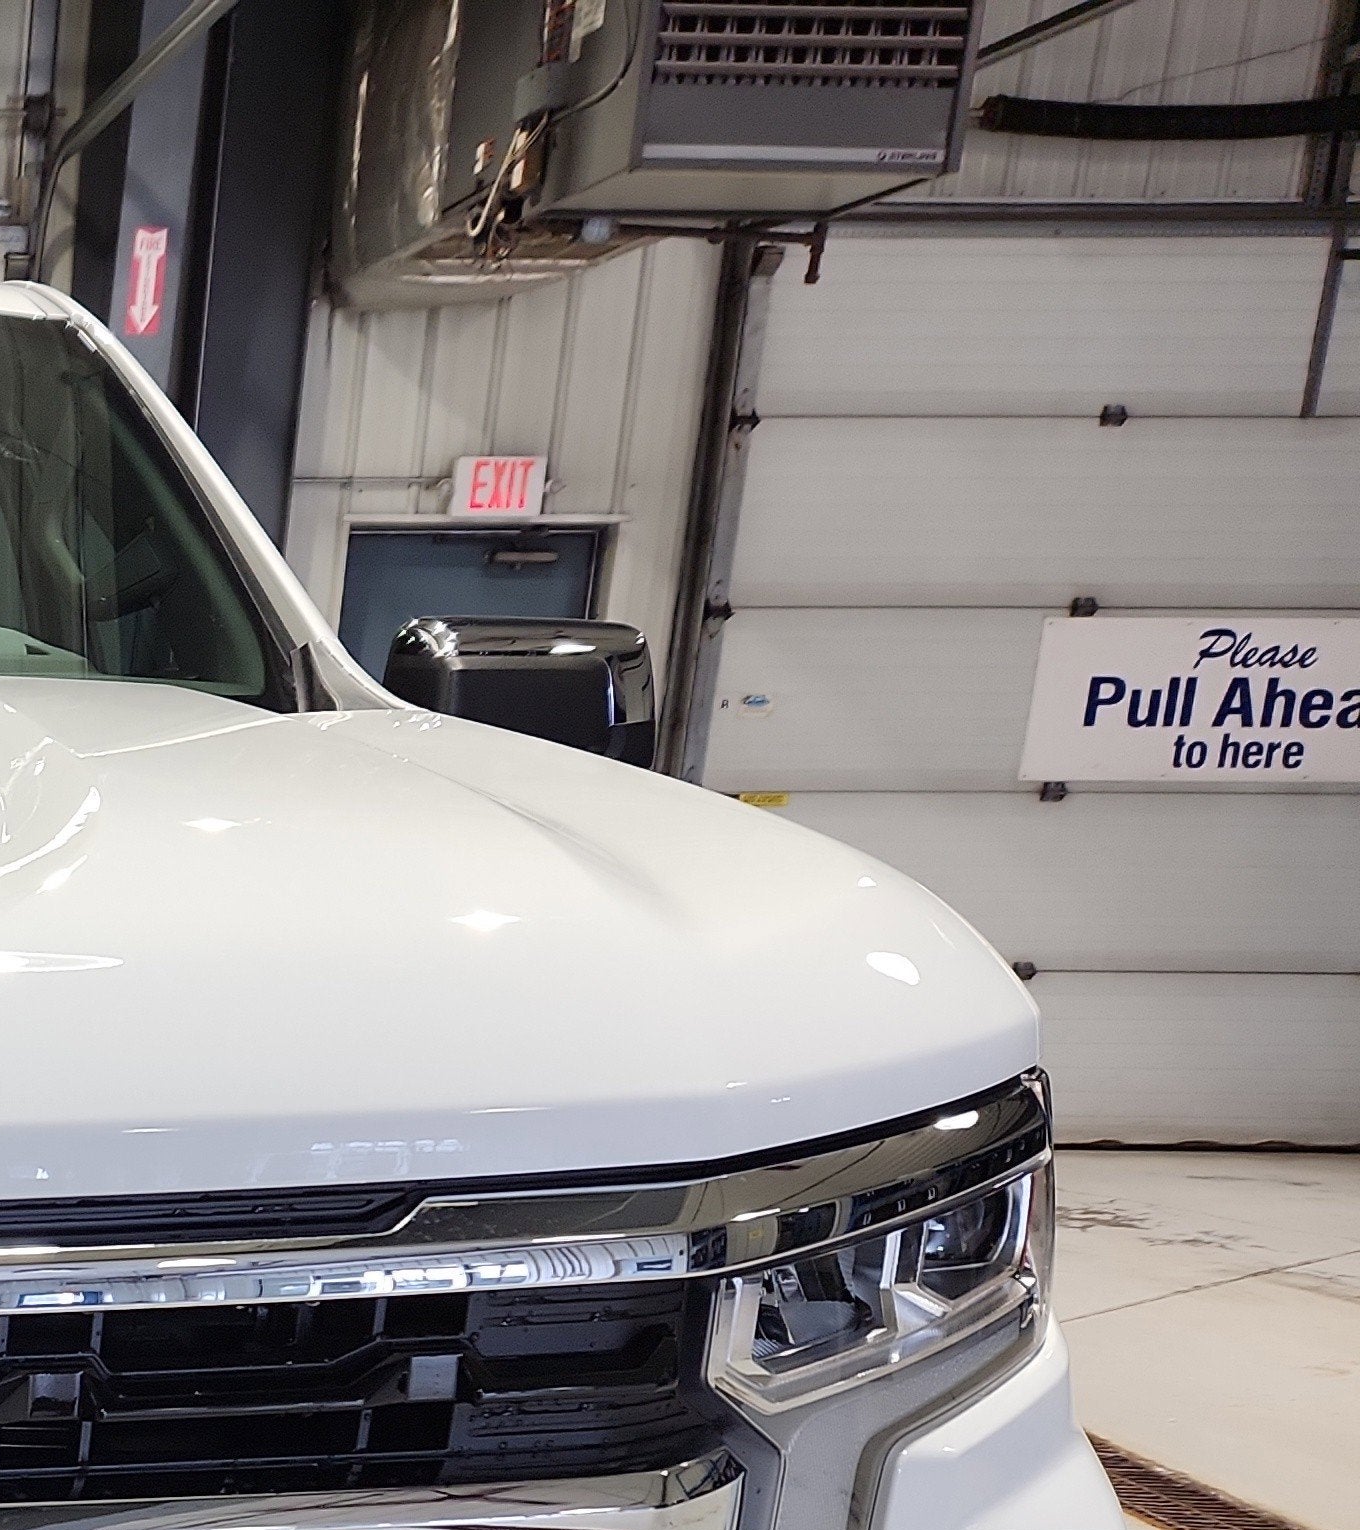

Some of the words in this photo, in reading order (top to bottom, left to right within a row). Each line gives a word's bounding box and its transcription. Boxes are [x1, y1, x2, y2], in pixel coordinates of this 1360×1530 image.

[470, 459, 535, 509] EXIT
[1193, 628, 1319, 669] Please
[1083, 676, 1198, 727] Pull
[1211, 676, 1360, 728] Ahea
[1173, 734, 1207, 769] to
[1217, 733, 1305, 769] here
